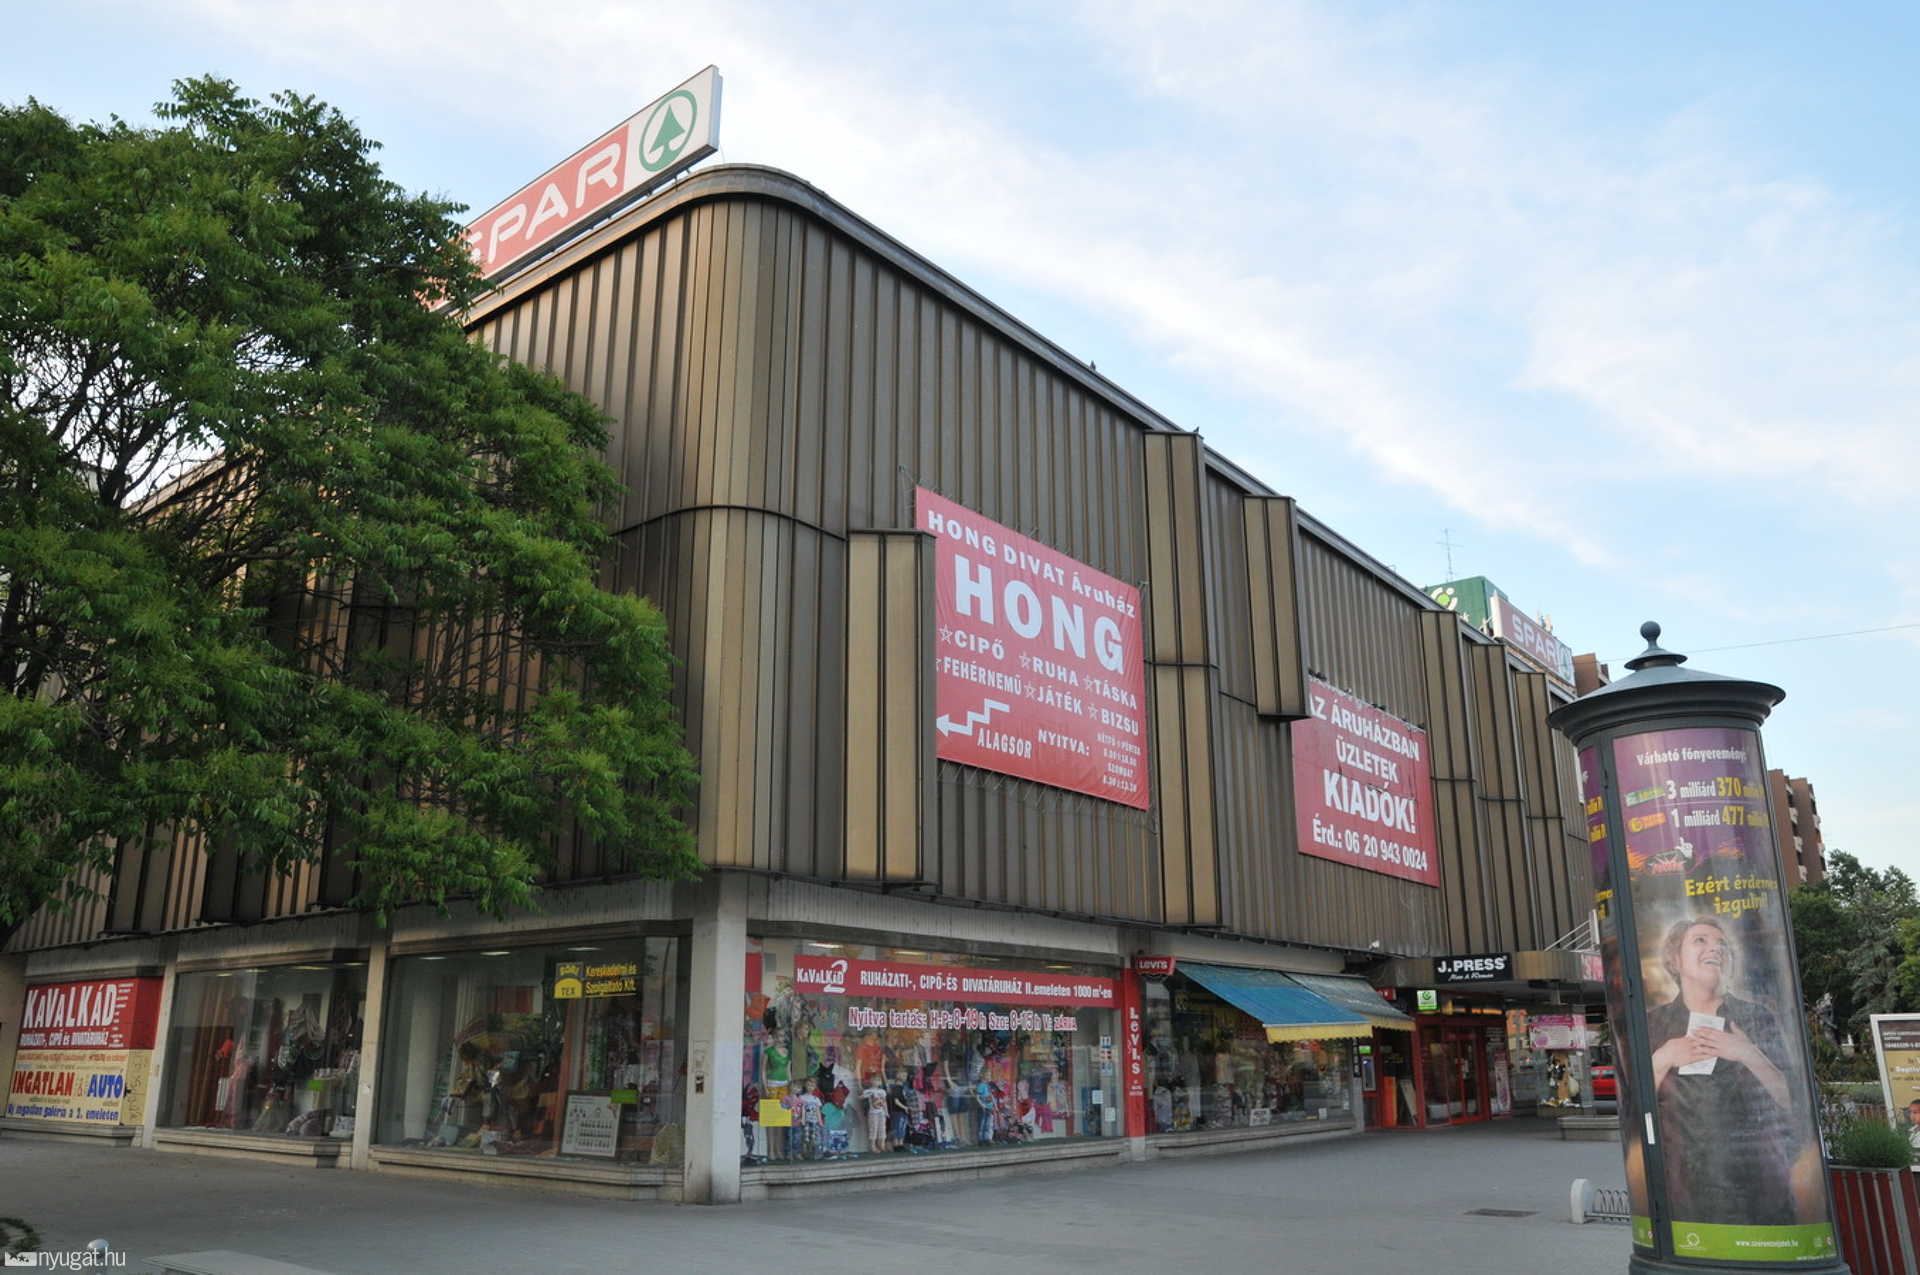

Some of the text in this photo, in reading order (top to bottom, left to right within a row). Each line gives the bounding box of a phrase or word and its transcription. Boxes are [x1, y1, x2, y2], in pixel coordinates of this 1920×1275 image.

[927, 510, 1136, 618] HONG DIVAT Áruház
[954, 553, 1124, 675] HONG
[1512, 614, 1556, 667] SPAR
[954, 628, 1137, 710] CIPŐ RUHA TÁSKA
[943, 656, 1139, 737] FEHÉRNEMŰ JÁTÉK BIZSU
[977, 728, 1032, 760] ALAGSOR
[1038, 728, 1090, 757] NYITVA:
[1330, 700, 1420, 762] ÁRUHÁZBAN
[1335, 736, 1398, 783] ÜZLETEK
[1636, 747, 1680, 767] Várható
[1323, 769, 1416, 834] KIADÓK!
[1665, 780, 1677, 799] 3
[1679, 780, 1717, 799] milliárd
[1716, 777, 1742, 797] 370
[1670, 808, 1680, 828] 1
[1684, 809, 1721, 828] milliárd
[1722, 805, 1745, 826] 477
[1344, 830, 1360, 854] 06
[1363, 834, 1378, 858] 20
[1380, 838, 1401, 865] 943
[1403, 846, 1428, 872] 0024
[1684, 875, 1730, 897] Ezért
[962, 975, 1023, 995] DIVATÁRUHÁZ
[849, 1006, 887, 1031] Nyitva
[889, 1008, 928, 1029] tartás:
[11, 1070, 75, 1097] INGATLAN
[87, 1069, 124, 1098] AUTÓ
